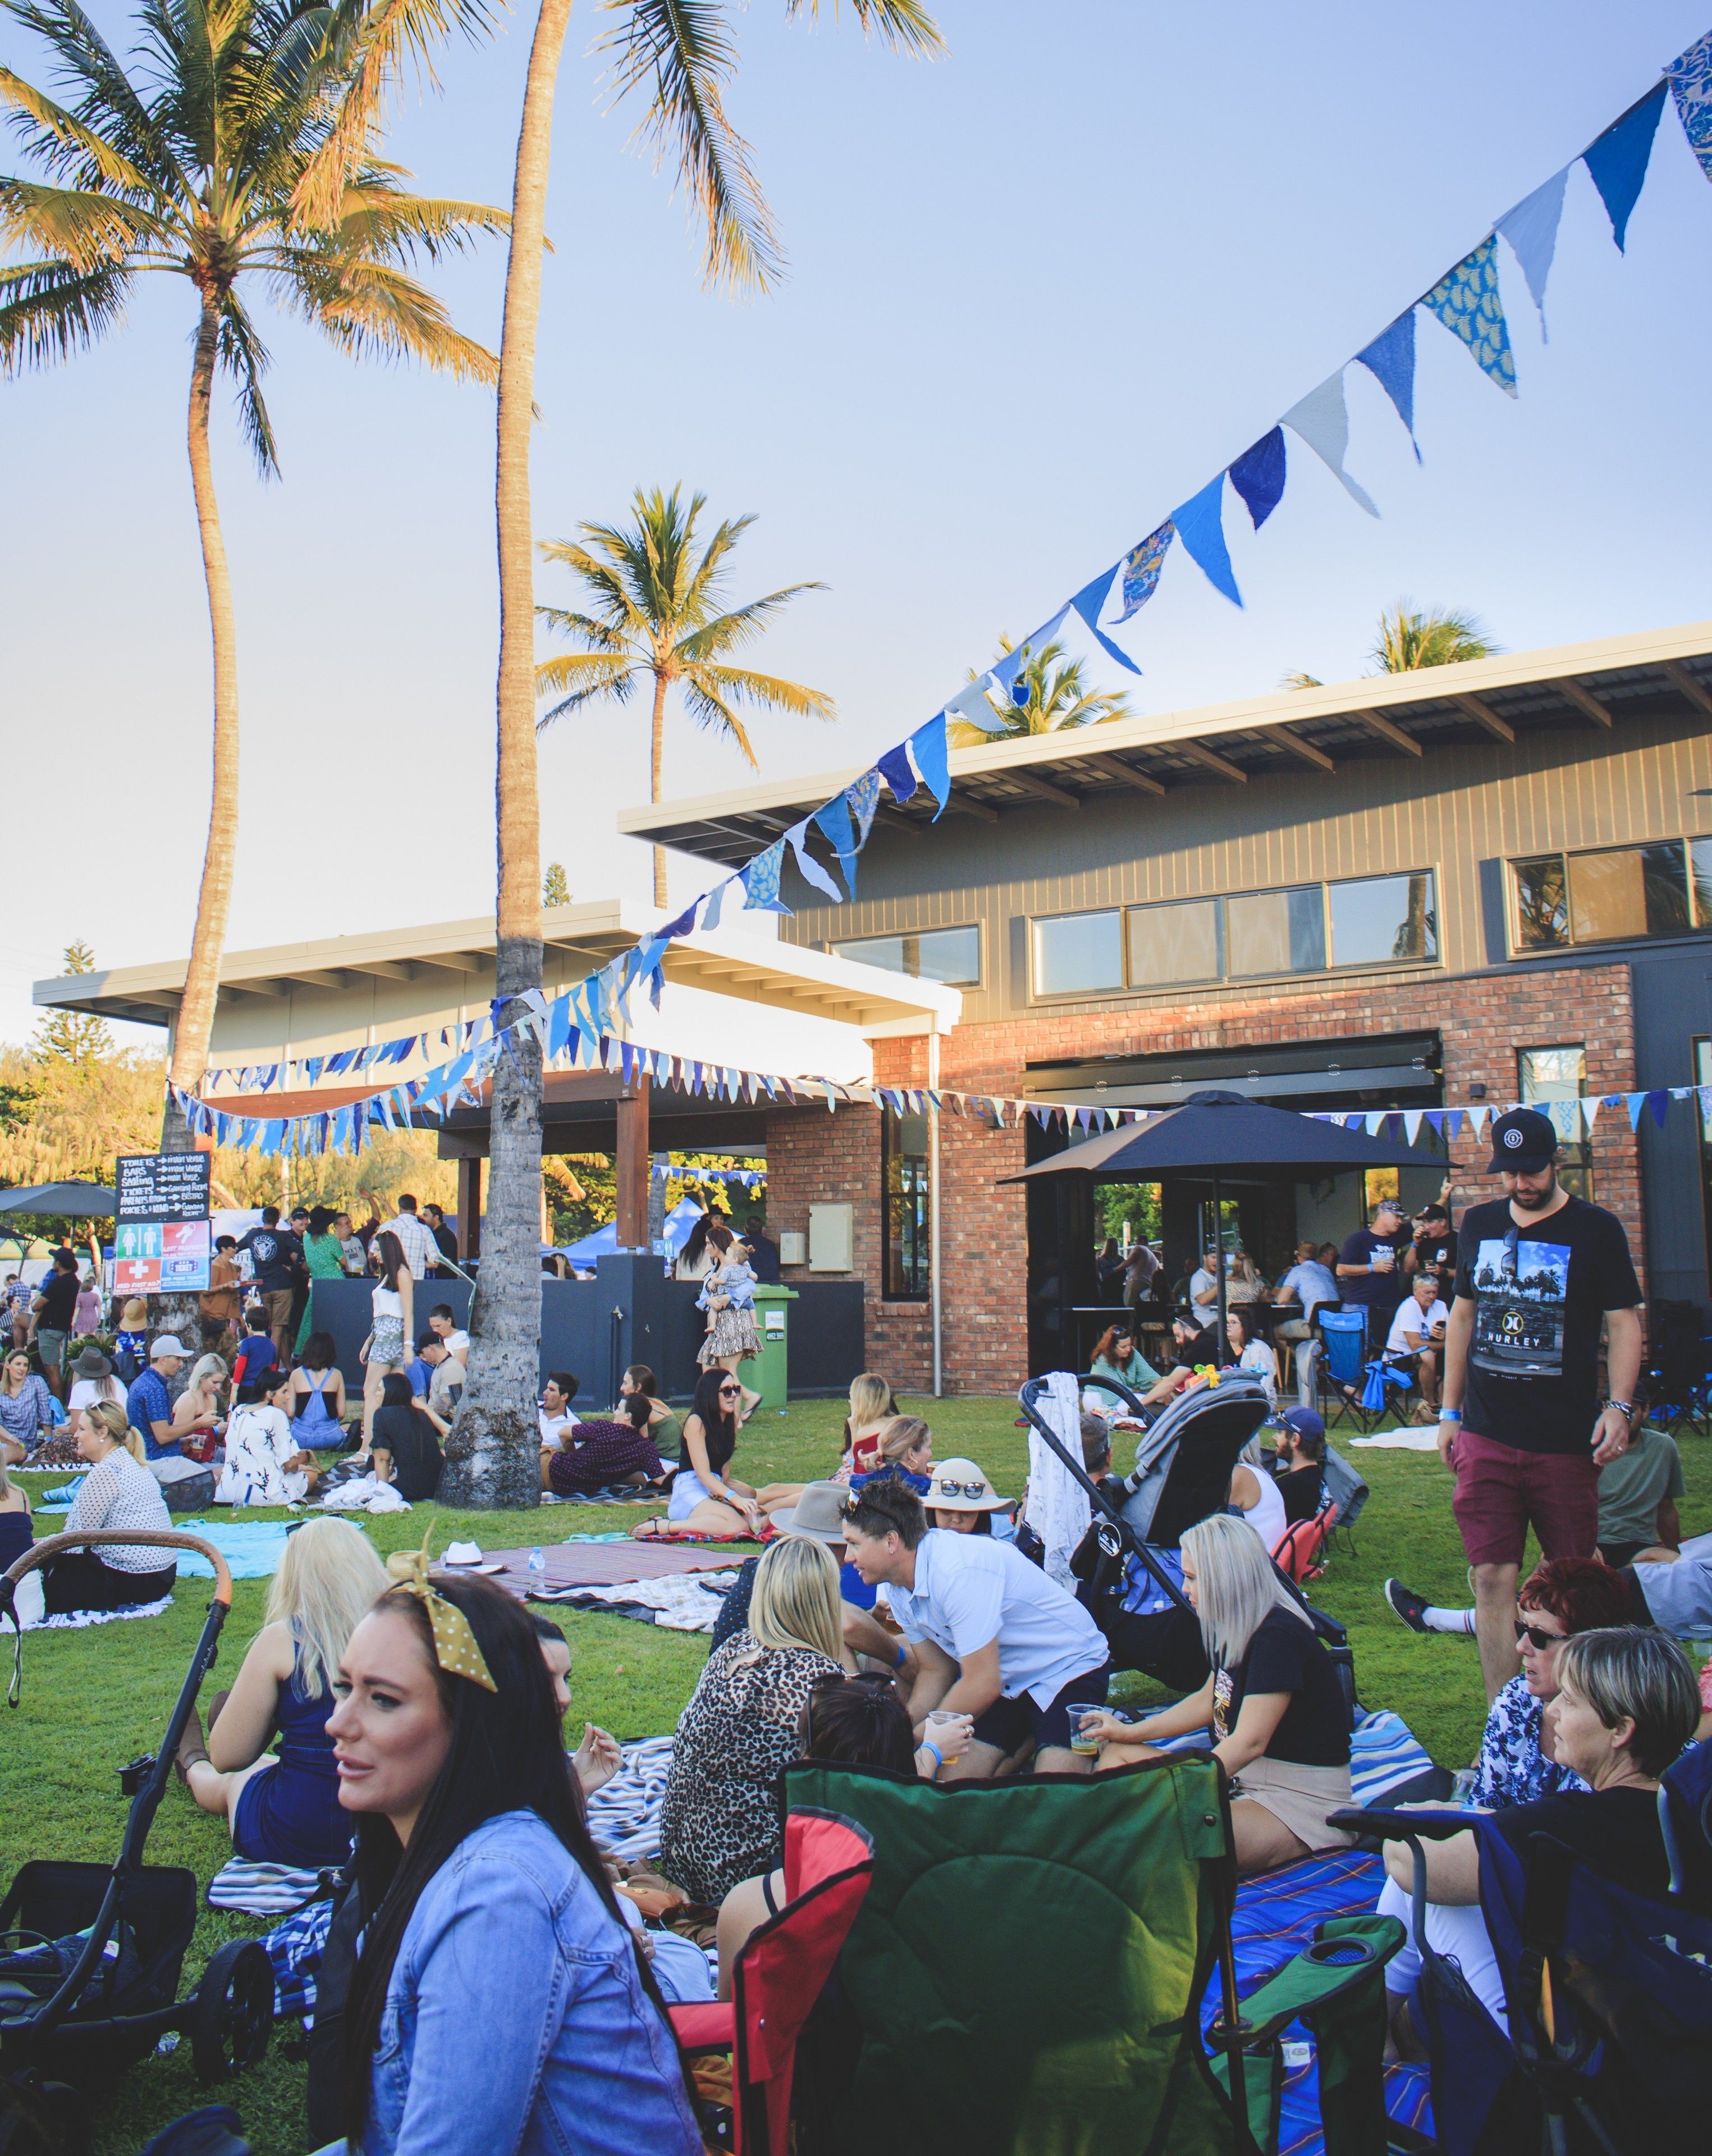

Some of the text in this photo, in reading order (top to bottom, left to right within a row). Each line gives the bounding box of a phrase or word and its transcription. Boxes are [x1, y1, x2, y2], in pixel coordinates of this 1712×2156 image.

[121, 1158, 155, 1167] TOILETS
[123, 1167, 147, 1177] BARS
[121, 1186, 154, 1196] TICKETS
[120, 1196, 149, 1205] PARENTS
[120, 1205, 148, 1215] POKIES
[1487, 1332, 1540, 1346] HURLEY
